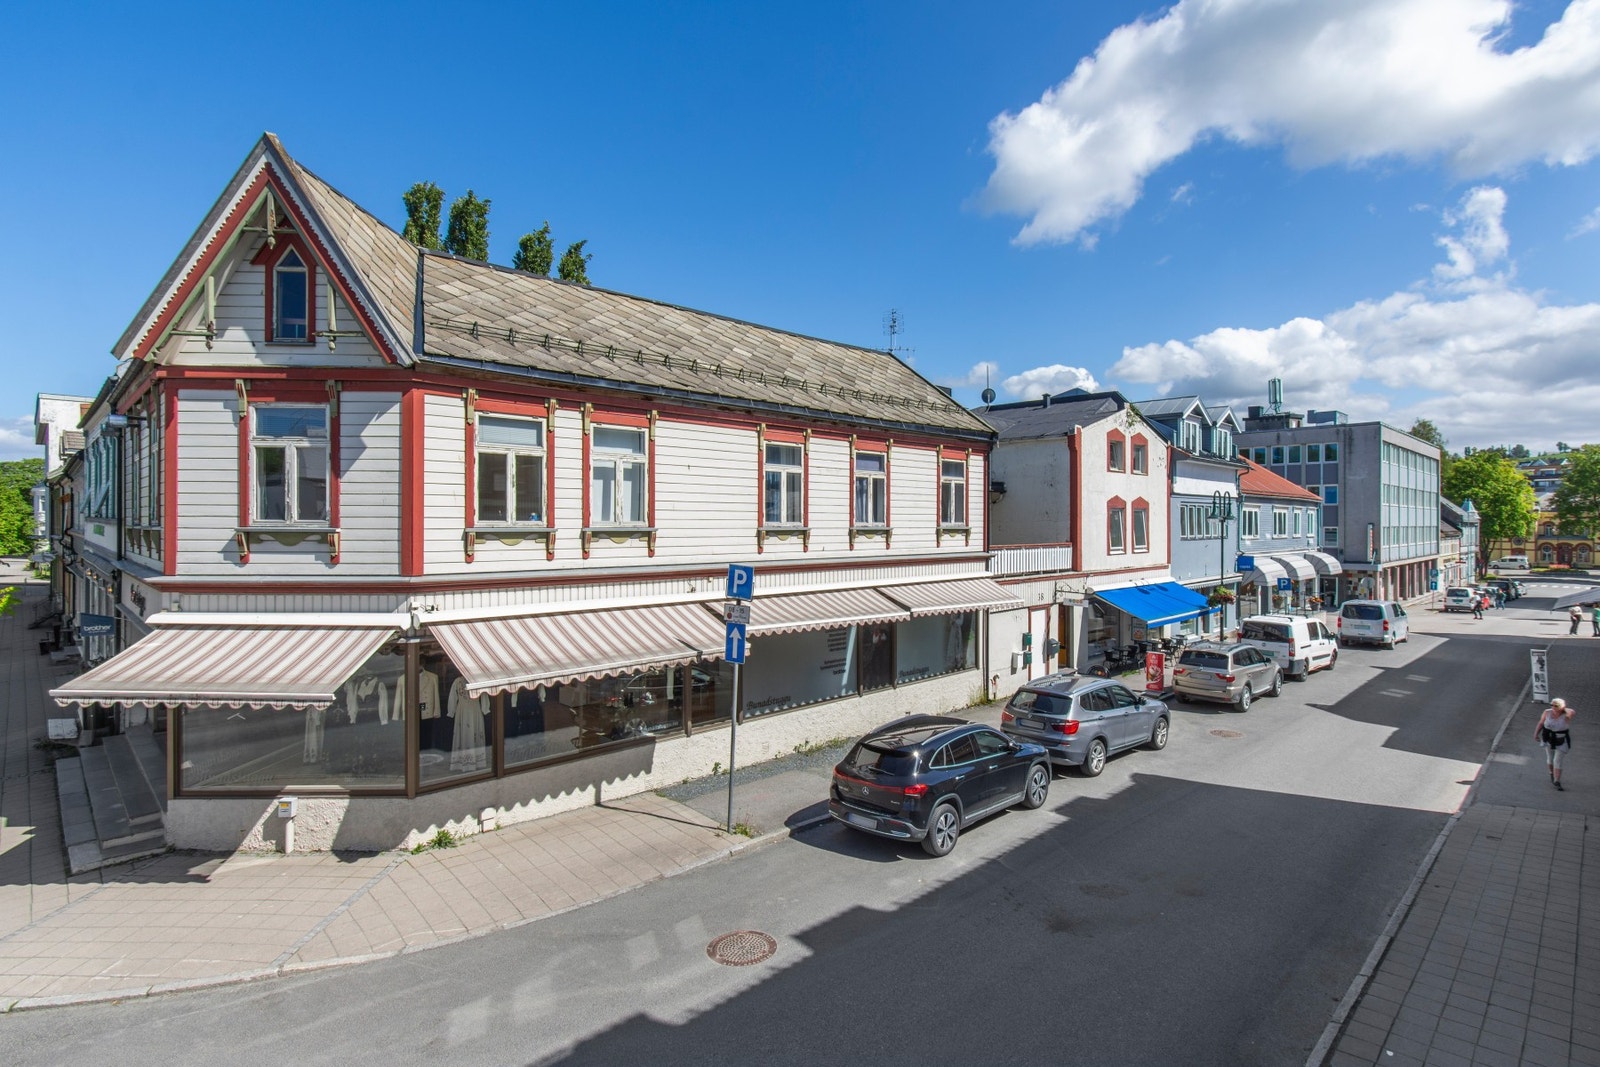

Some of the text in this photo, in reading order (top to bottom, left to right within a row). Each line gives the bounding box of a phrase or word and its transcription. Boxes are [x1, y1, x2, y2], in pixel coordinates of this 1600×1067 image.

[733, 569, 747, 594] P
[1280, 579, 1288, 589] P
[83, 624, 112, 632] brother
